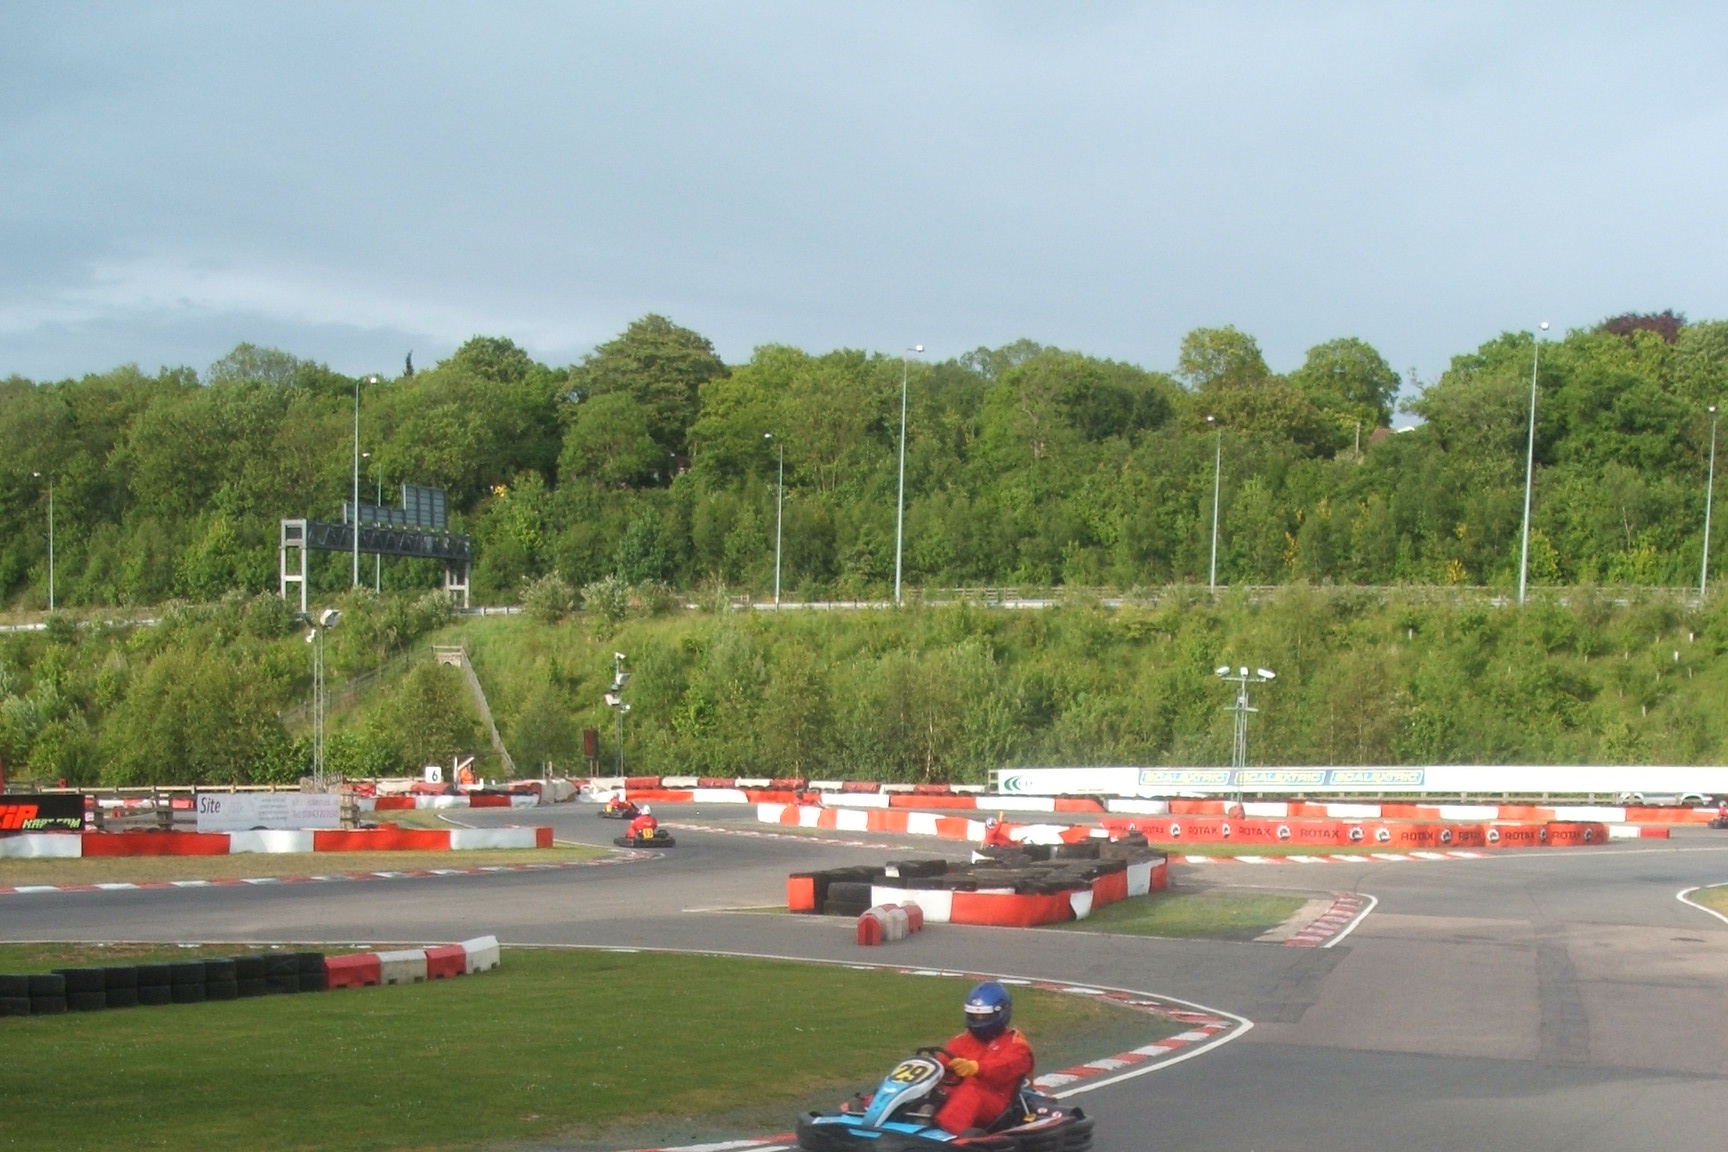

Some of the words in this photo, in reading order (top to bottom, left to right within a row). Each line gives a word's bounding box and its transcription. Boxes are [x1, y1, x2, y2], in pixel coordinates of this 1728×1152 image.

[431, 770, 439, 782] 6
[1147, 771, 1227, 783] SCALEXTRIC
[1336, 771, 1418, 783] SCALEXTRIC
[199, 796, 221, 814] Site
[1188, 826, 1218, 835] ROTAX
[1239, 826, 1271, 836] ROTAX
[1301, 828, 1339, 838] ROTAX
[1401, 831, 1435, 841] ROTAX
[890, 1064, 928, 1082] 29
